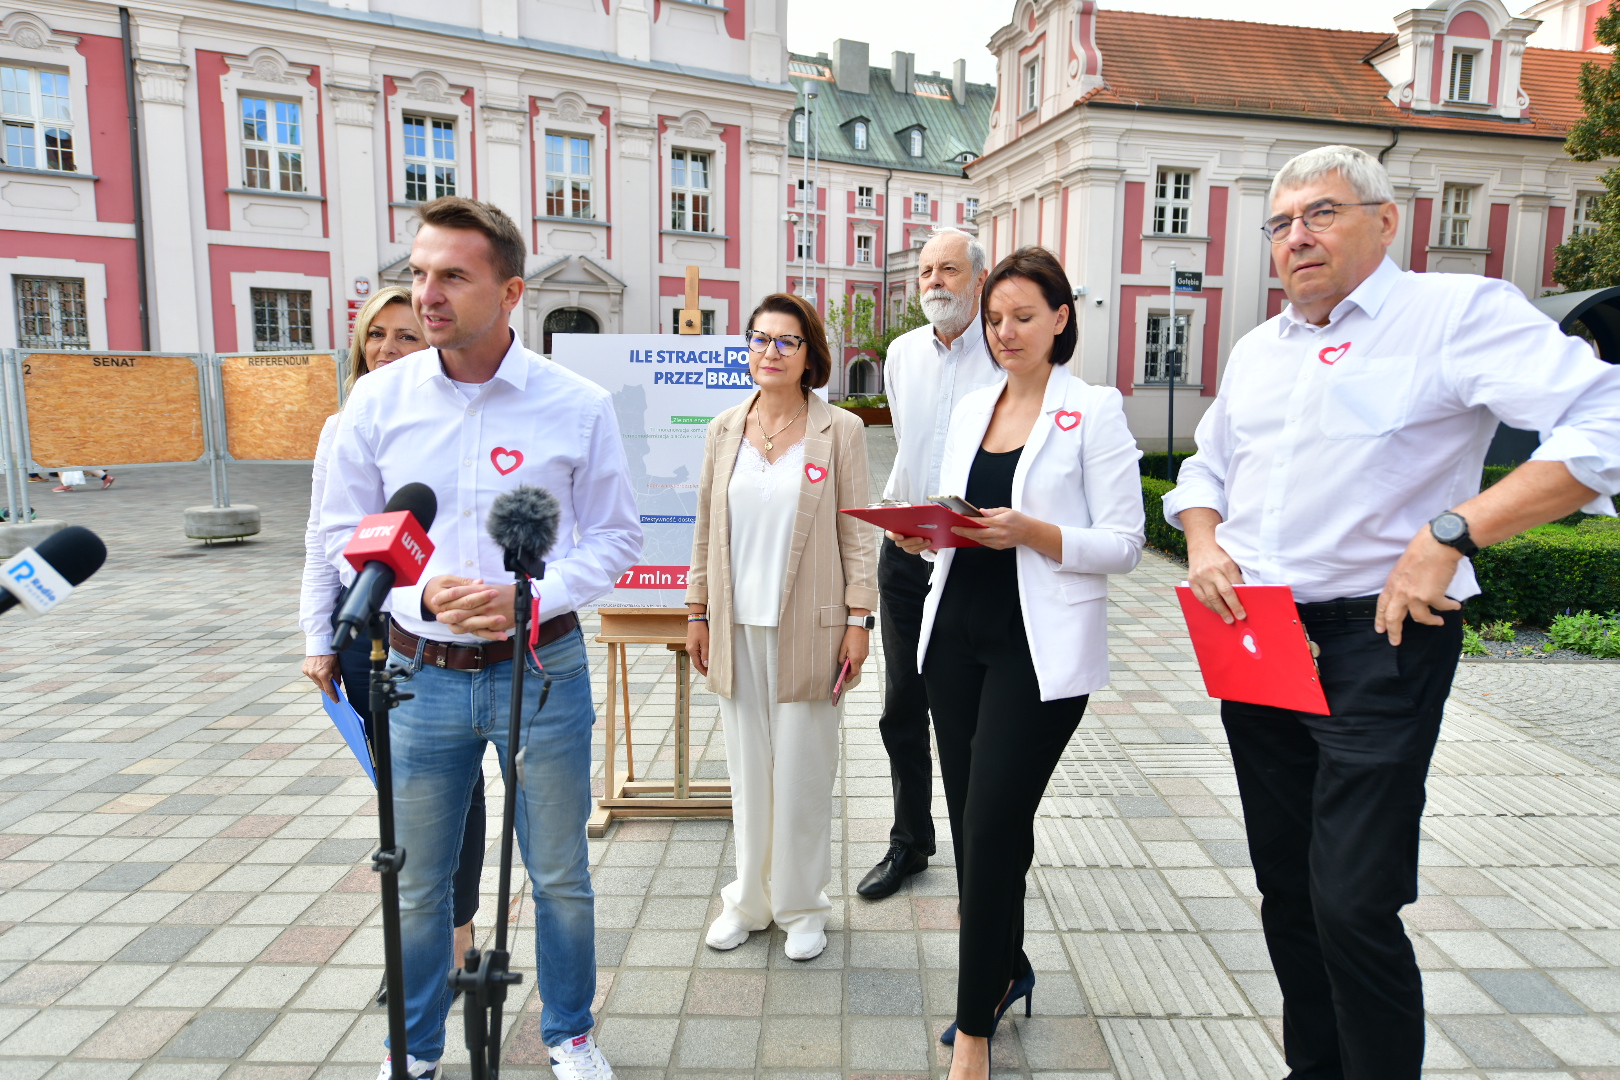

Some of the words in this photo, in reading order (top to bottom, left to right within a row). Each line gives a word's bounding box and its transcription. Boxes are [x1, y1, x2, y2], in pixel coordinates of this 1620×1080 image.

[1178, 278, 1199, 286] Gołębia
[92, 357, 136, 367] SENAT
[248, 356, 310, 366] REFERENDUM
[629, 349, 653, 363] ILE
[656, 350, 724, 364] STRACIŁ
[23, 364, 32, 375] 2
[653, 371, 704, 385] PRZEZ
[707, 371, 753, 386] BRAK
[639, 570, 672, 585] mln
